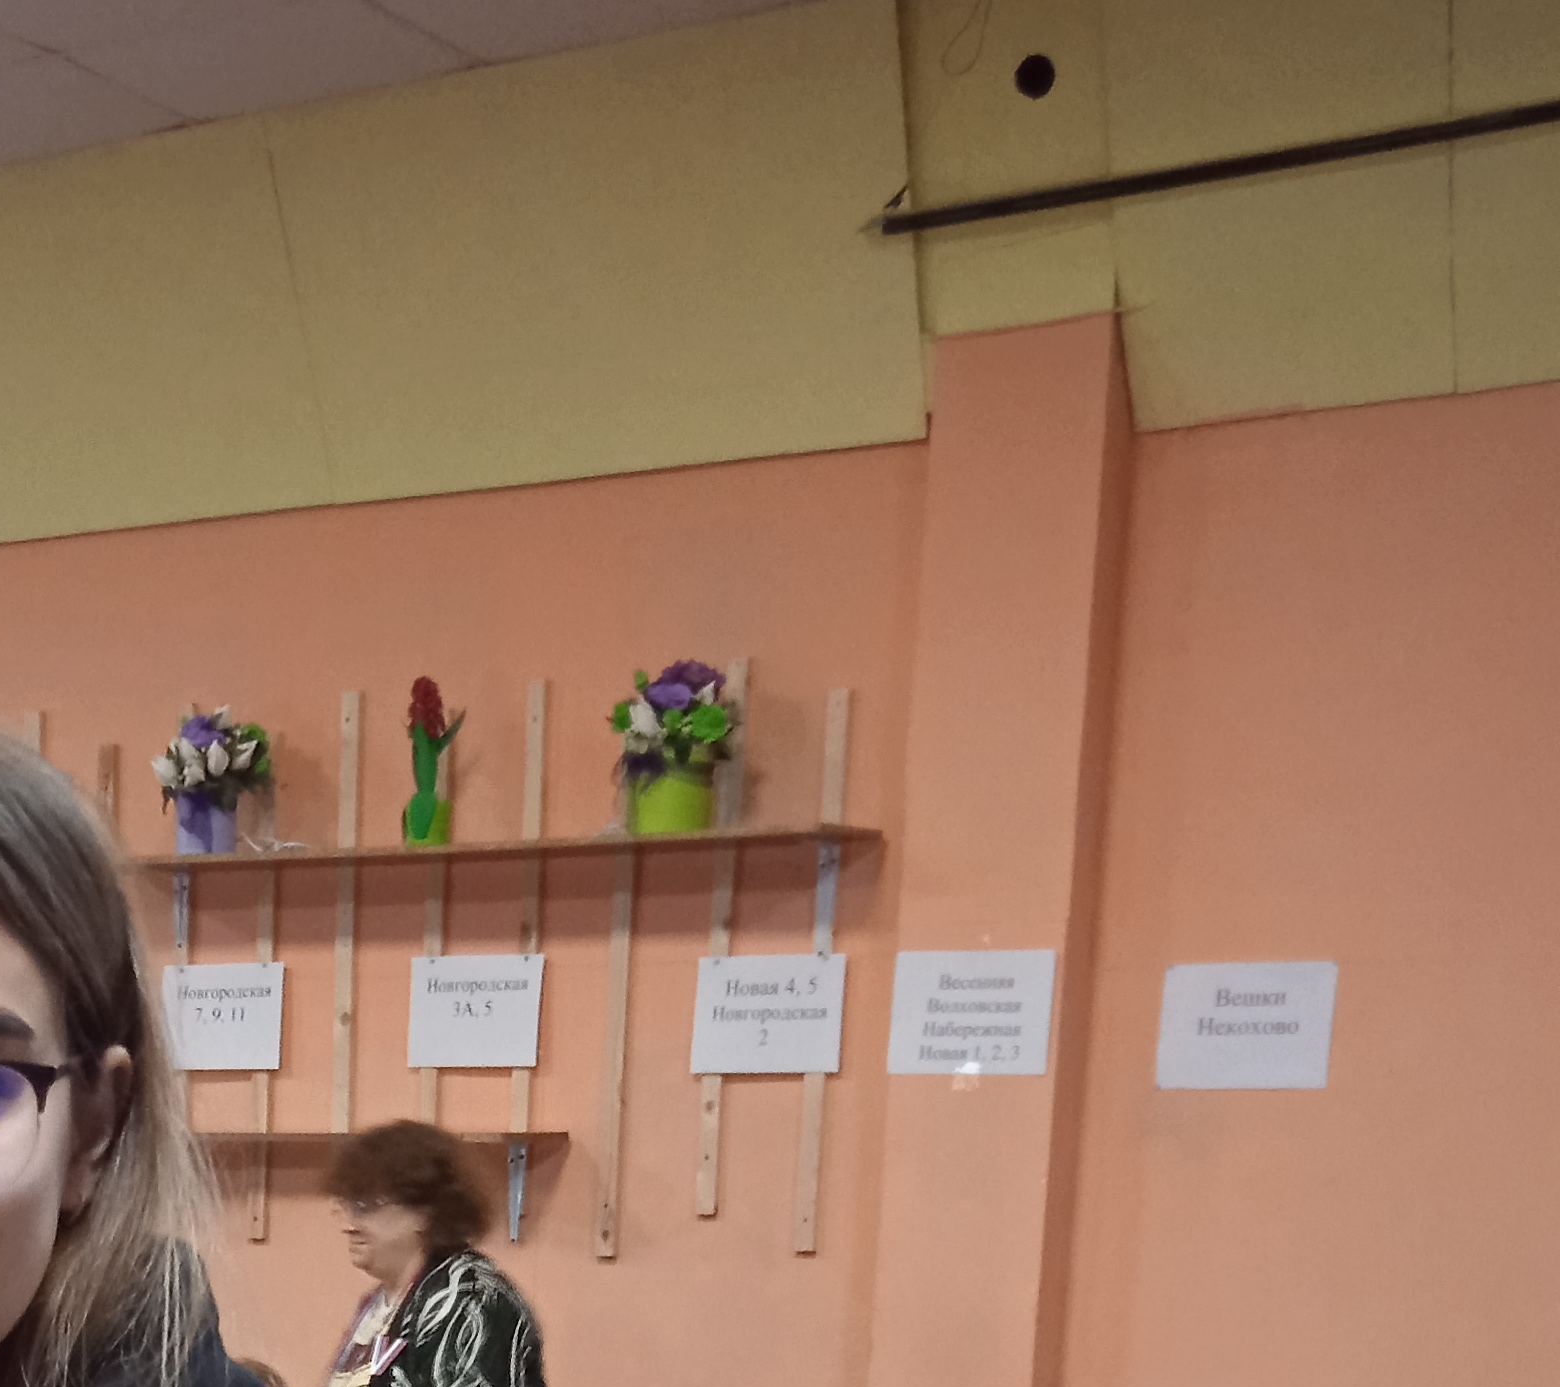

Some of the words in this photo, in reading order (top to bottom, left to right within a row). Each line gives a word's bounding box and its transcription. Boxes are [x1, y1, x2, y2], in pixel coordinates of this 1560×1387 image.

[177, 985, 272, 1002] Новгородская
[427, 978, 529, 995] Новгородская
[726, 978, 779, 996] Новая
[807, 976, 818, 995] 5
[1216, 988, 1287, 1007] Вешки
[231, 1007, 245, 1021] 11
[484, 999, 494, 1017] 5
[1197, 1017, 1300, 1036] Некохово
[757, 1027, 769, 1046] 2
